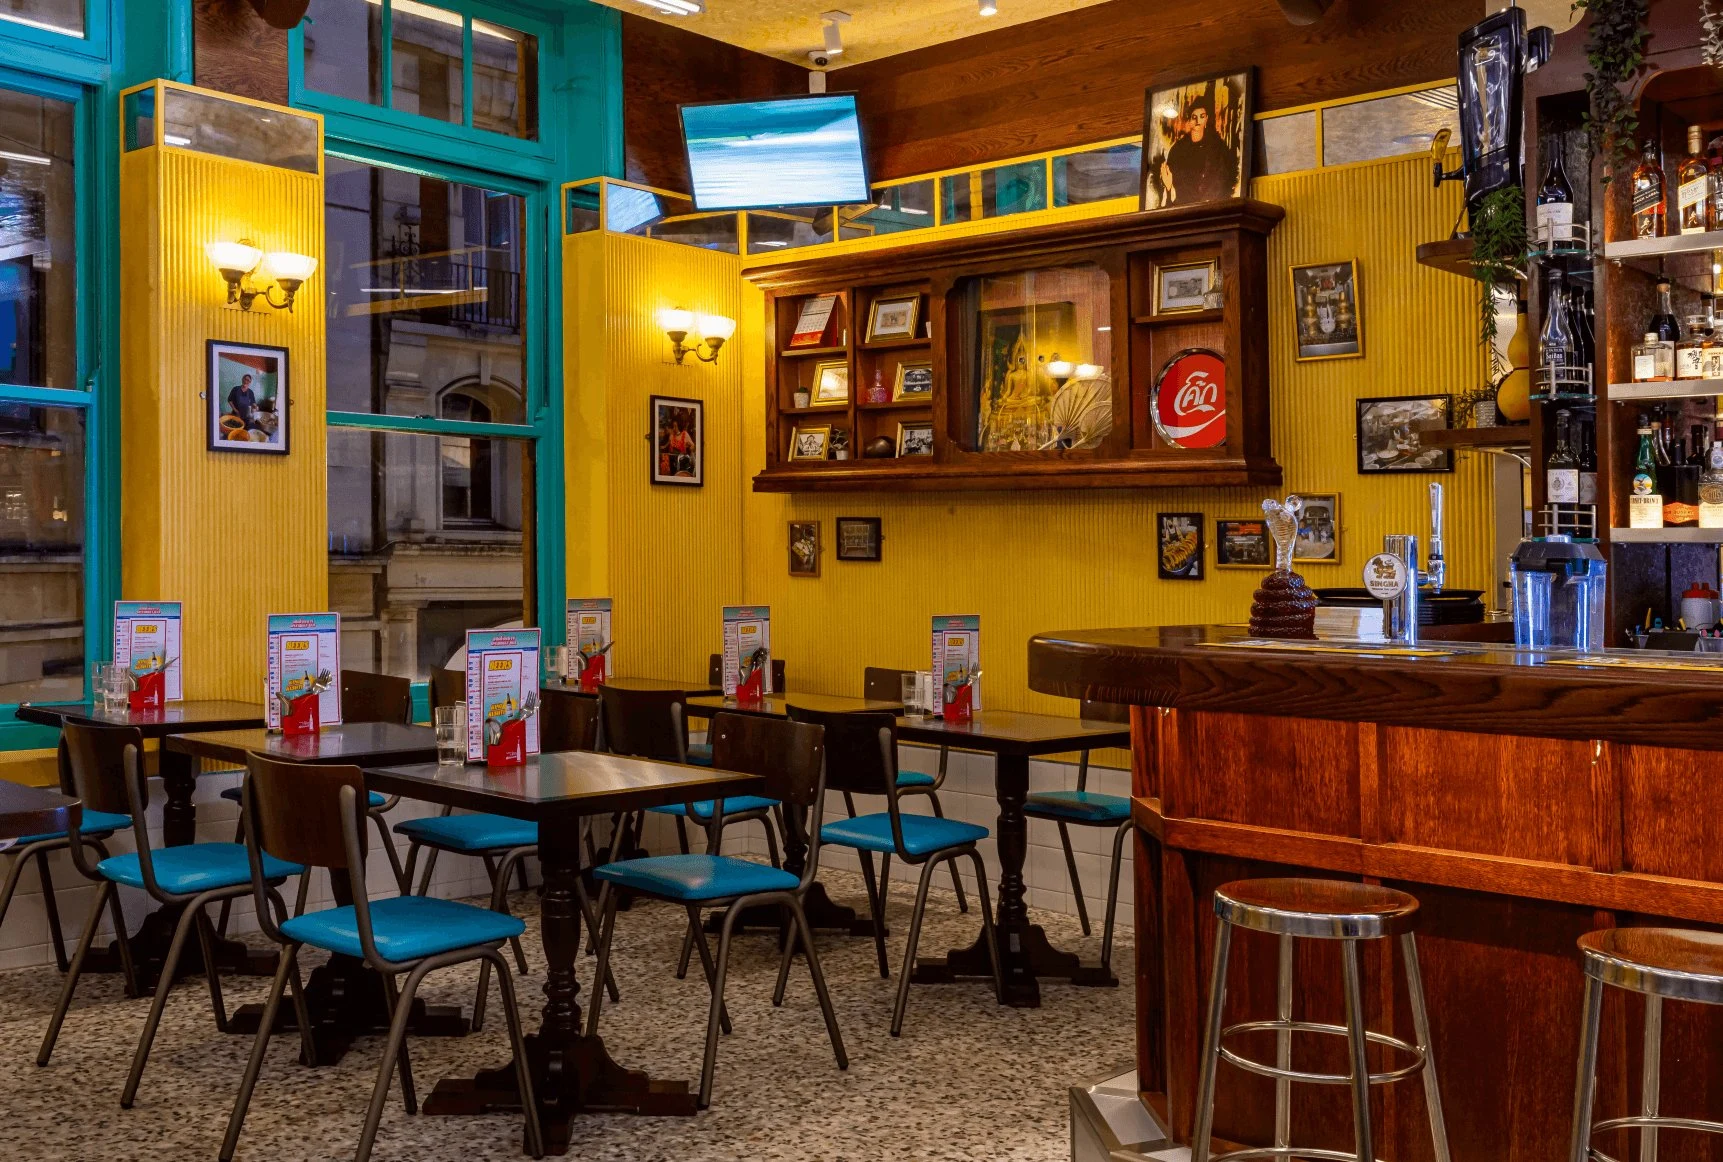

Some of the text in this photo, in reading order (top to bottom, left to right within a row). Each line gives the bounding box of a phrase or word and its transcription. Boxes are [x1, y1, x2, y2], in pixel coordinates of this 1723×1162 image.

[1370, 580, 1399, 588] SINGHA
[135, 625, 158, 634] BEERS
[285, 640, 309, 651] BEERS
[488, 659, 513, 671] BEERS
